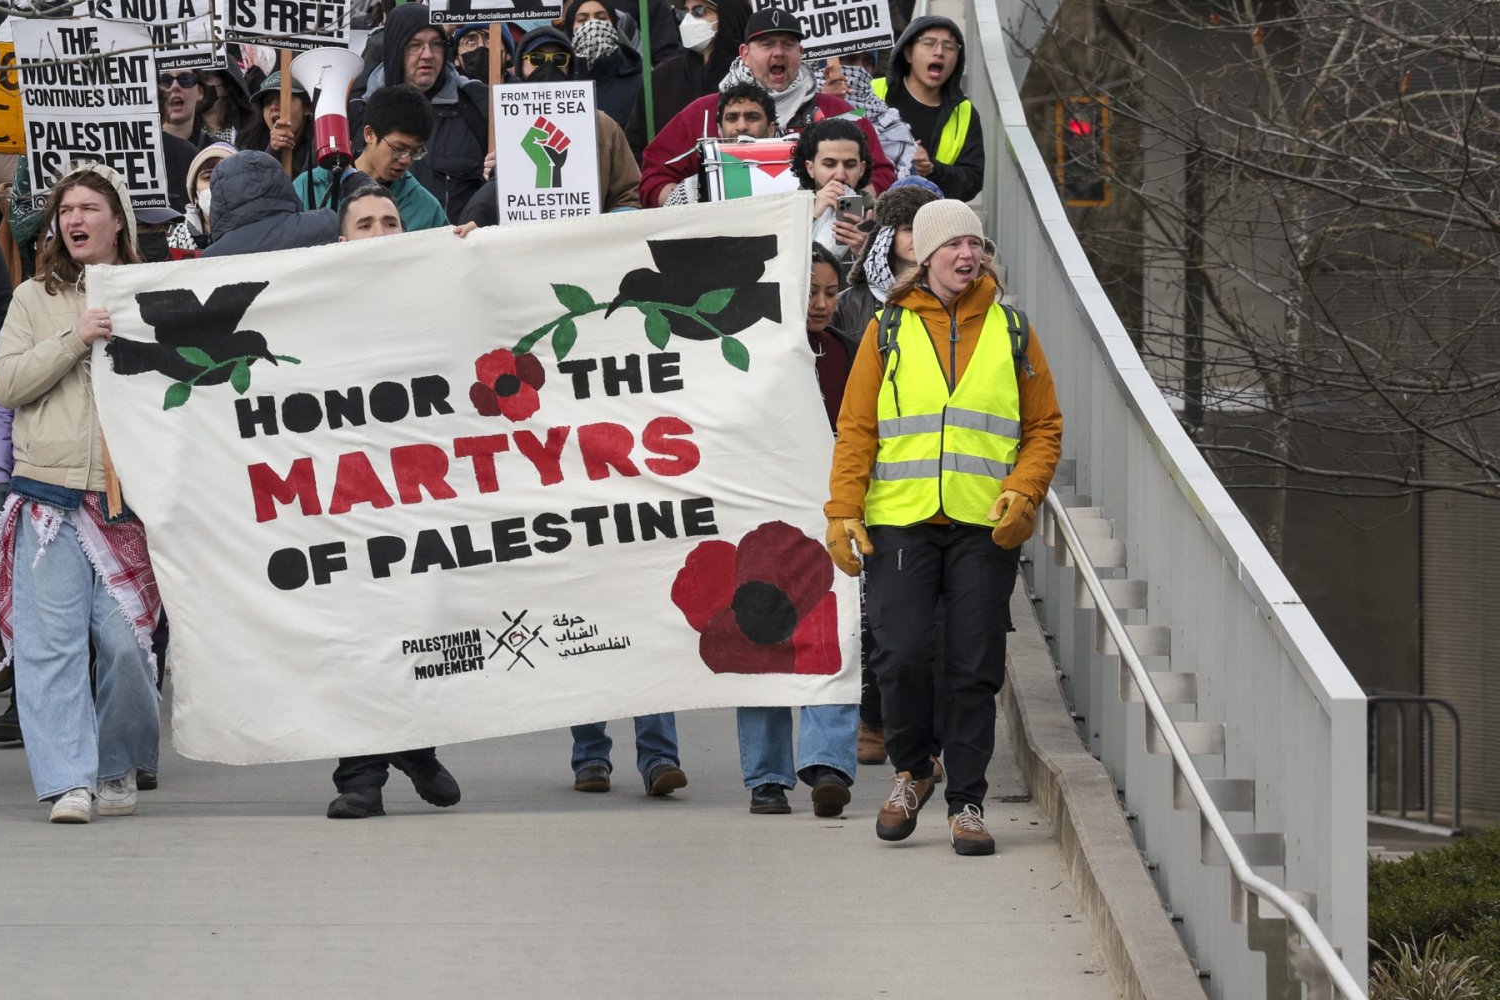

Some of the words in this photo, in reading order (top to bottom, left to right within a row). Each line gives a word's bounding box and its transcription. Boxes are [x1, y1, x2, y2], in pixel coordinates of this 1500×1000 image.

[446, 14, 465, 22] Party
[478, 12, 510, 20] Socialism
[525, 10, 560, 18] Liberation
[57, 27, 100, 54] THE
[268, 39, 299, 49] Socialism
[300, 42, 313, 50] and
[808, 47, 842, 58] Socialism
[843, 44, 856, 53] and
[857, 39, 892, 50] Liberation
[20, 55, 149, 86] MOVEMENT
[176, 57, 211, 67] Liberation
[25, 88, 106, 107] CONTINUES
[108, 86, 153, 106] UNTIL
[501, 92, 529, 101] FROM
[532, 91, 551, 100] THE
[555, 89, 585, 99] RIVER
[501, 104, 519, 116] TO
[523, 103, 552, 115] THE
[557, 101, 586, 114] SEA
[29, 120, 155, 150] PALESTINE
[32, 151, 64, 190] IS
[507, 192, 591, 207] PALESTINE
[507, 210, 537, 221] WILL
[541, 209, 556, 220] BE
[235, 374, 454, 440] HONOR
[558, 351, 684, 400] THE
[248, 416, 700, 523] MARTYRS
[267, 540, 348, 591] OF
[366, 497, 719, 580] PALESTINE
[553, 614, 585, 627] حركة
[402, 629, 481, 654] PALESTINIAN
[555, 624, 598, 643] الشباب
[442, 642, 483, 662] YOUTH
[558, 636, 631, 660] الفلسطيني
[414, 656, 486, 680] MOVEMENT
